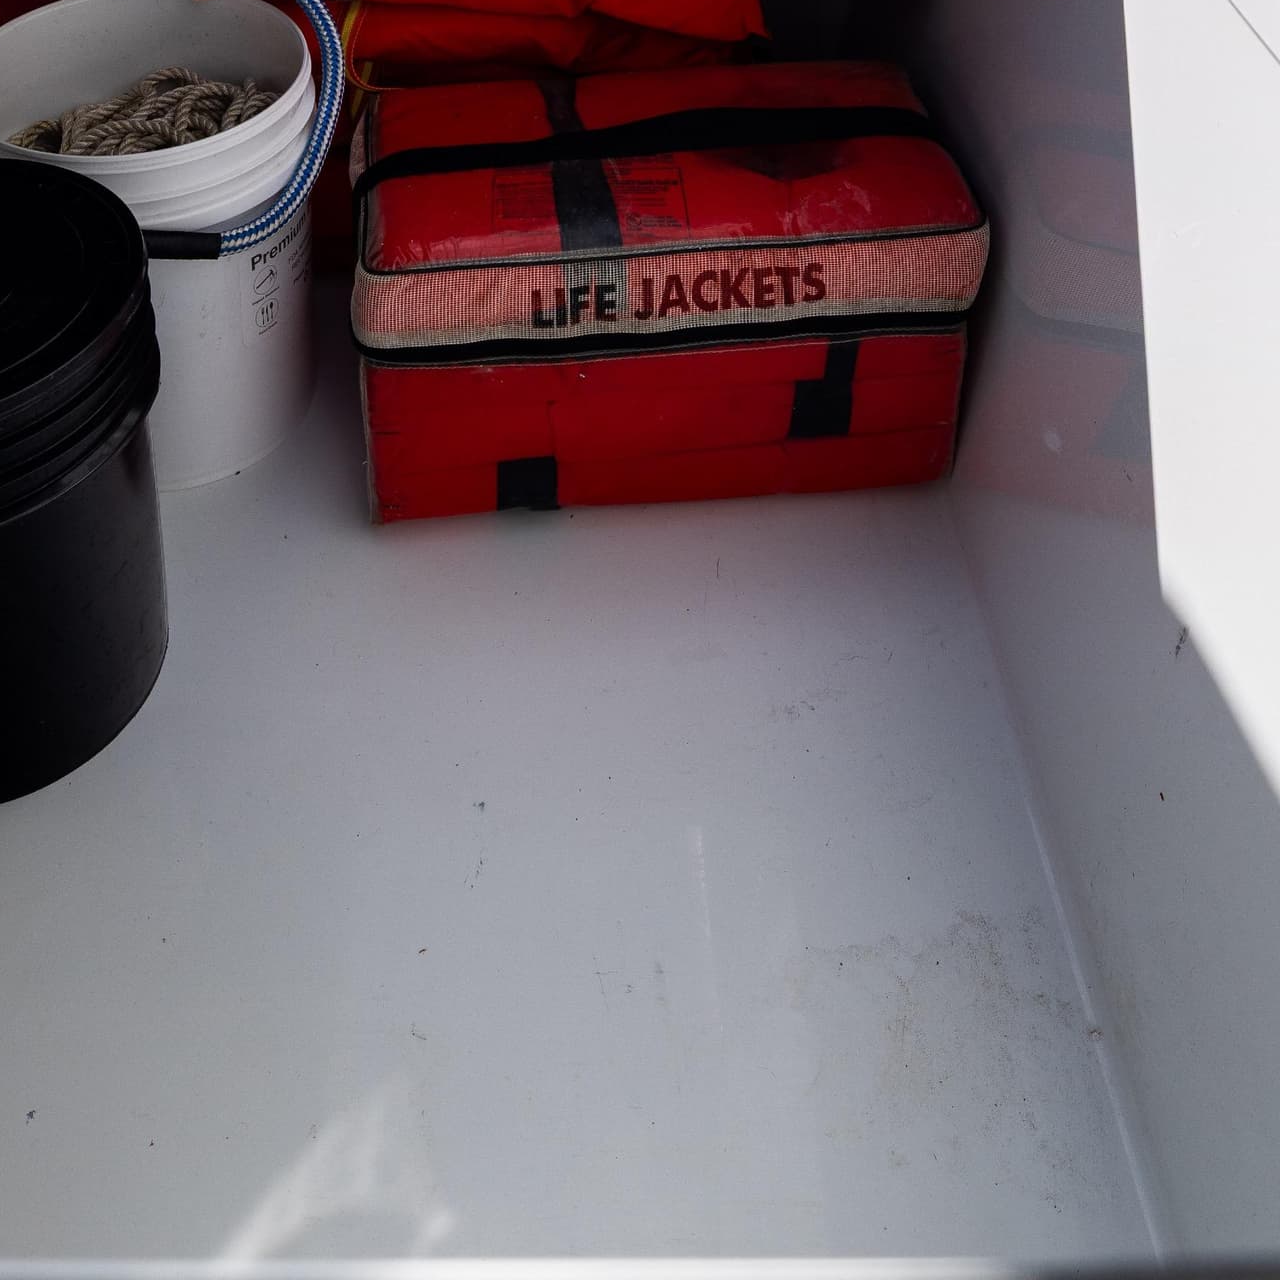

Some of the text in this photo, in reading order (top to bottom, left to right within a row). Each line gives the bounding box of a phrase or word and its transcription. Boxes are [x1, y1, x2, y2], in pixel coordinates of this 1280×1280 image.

[251, 213, 306, 271] Premium
[531, 263, 827, 328] LIFE JACKETS
